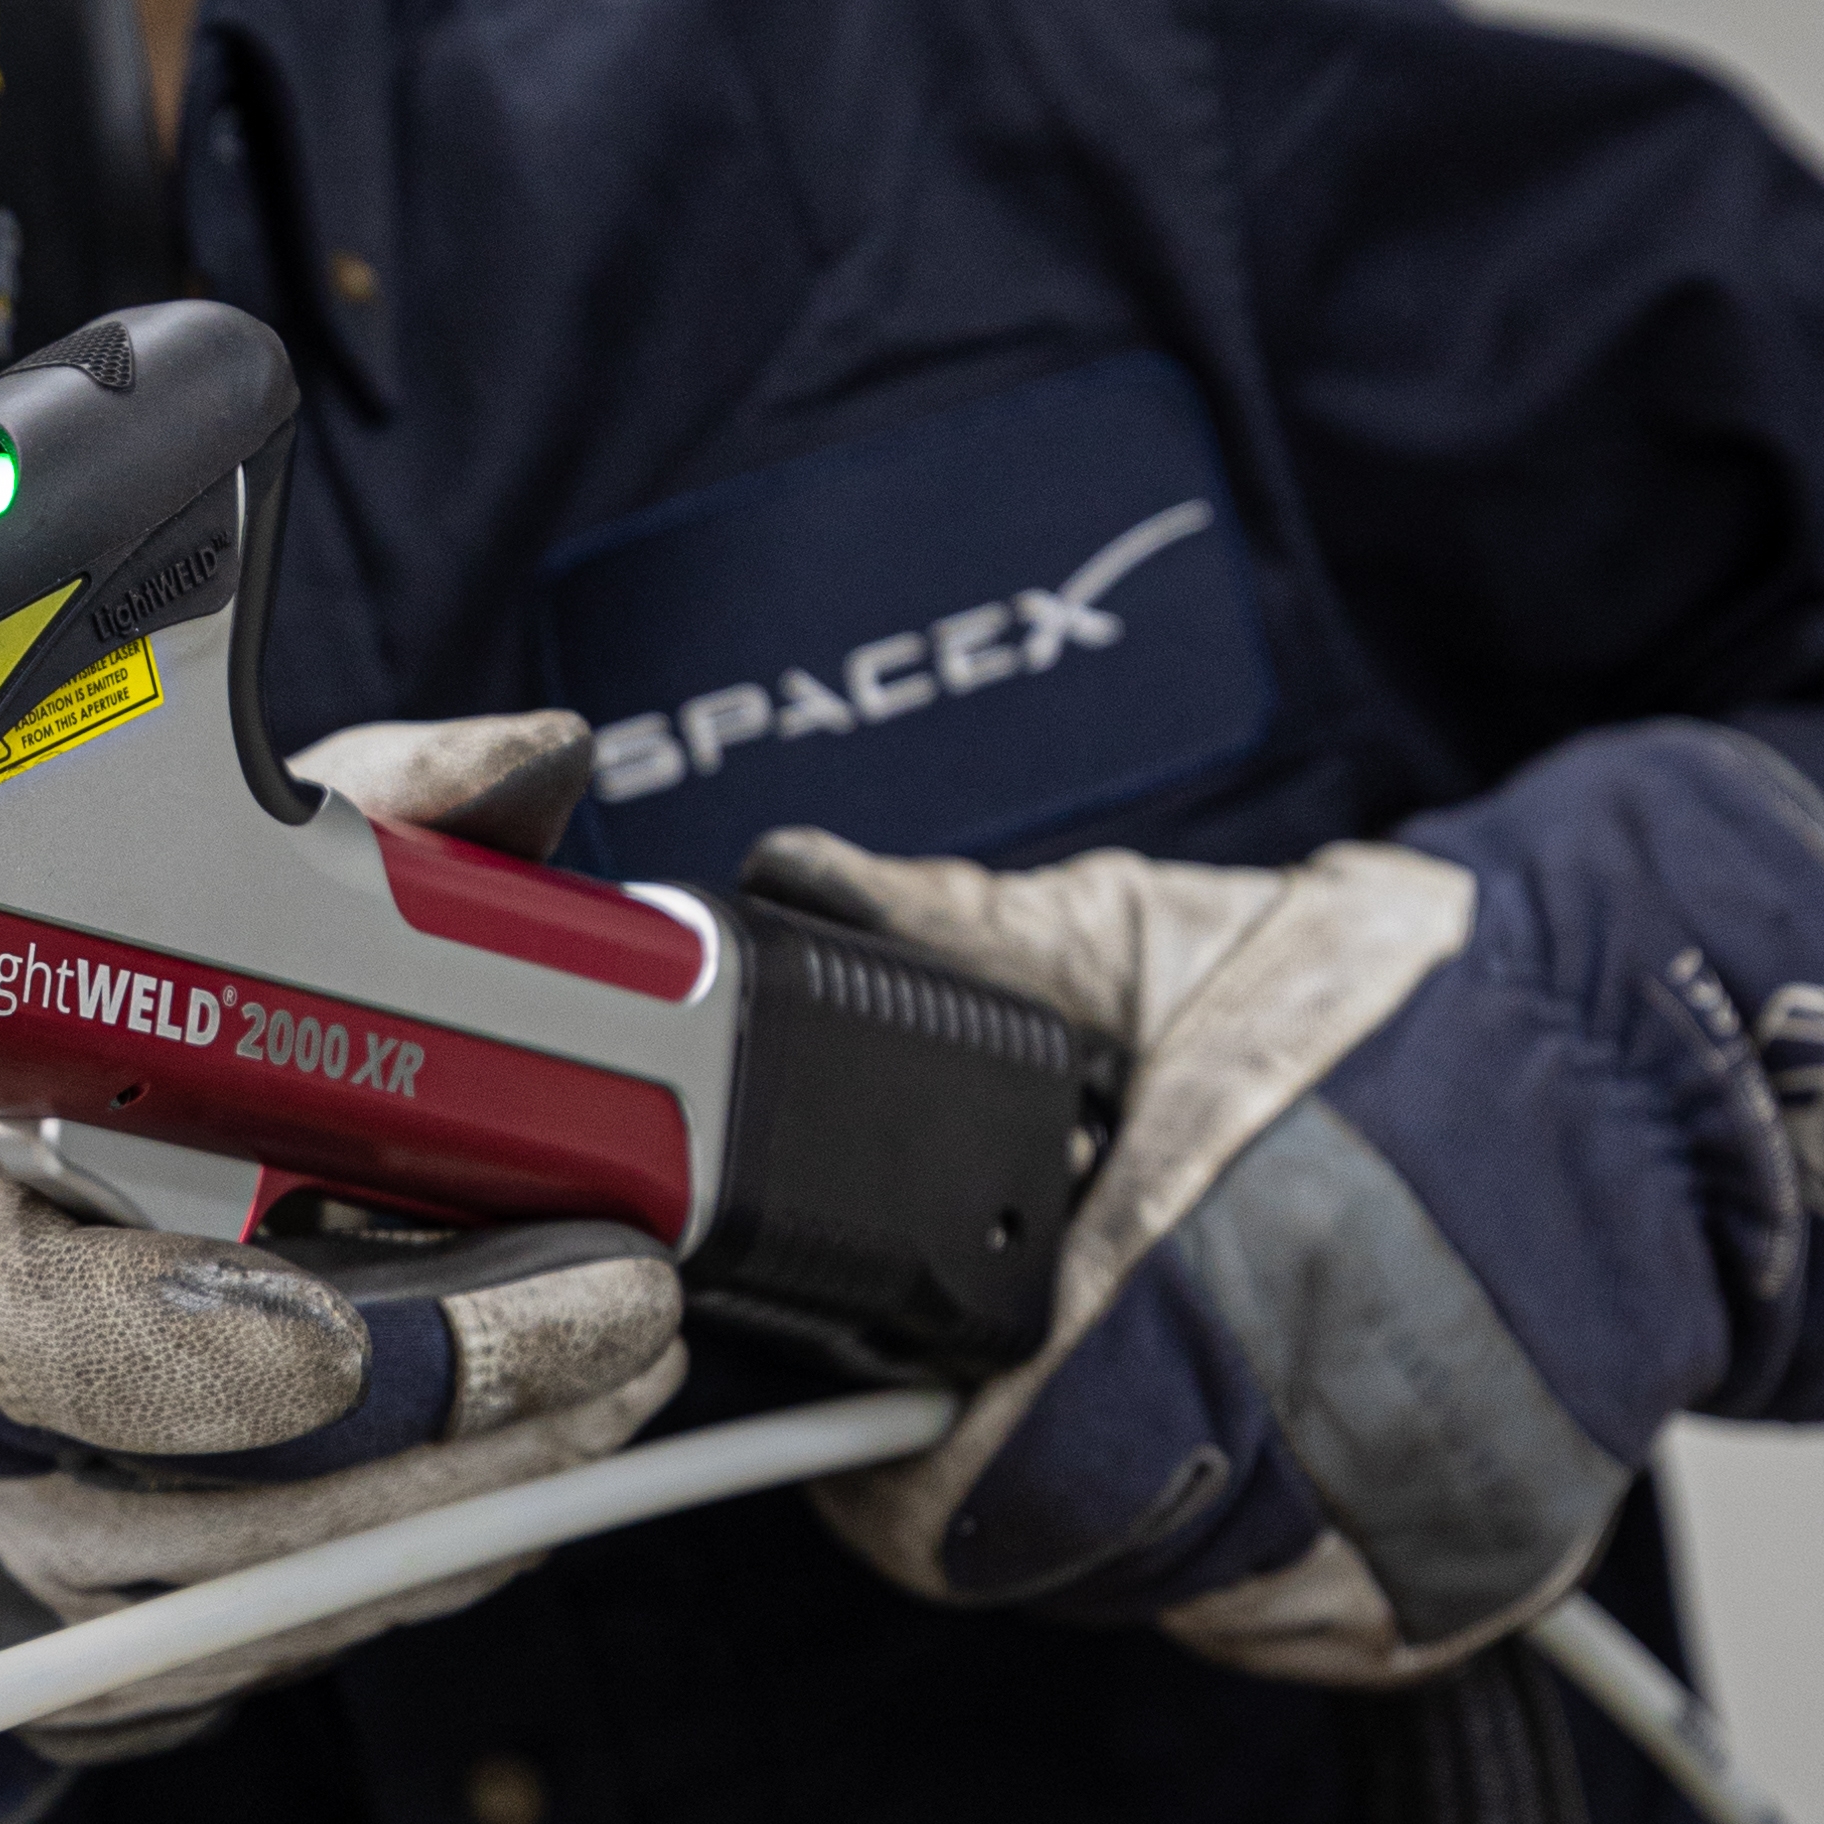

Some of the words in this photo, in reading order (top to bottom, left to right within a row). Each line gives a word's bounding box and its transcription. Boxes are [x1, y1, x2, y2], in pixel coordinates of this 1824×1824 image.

[109, 641, 141, 666] LASER
[590, 497, 1215, 805] SPACEX
[75, 687, 86, 703] IS
[87, 667, 128, 697] EMITTED
[21, 723, 55, 749] FROM
[55, 711, 78, 733] THIS
[80, 686, 130, 722] APERTURE
[236, 1002, 349, 1080] 2000
[350, 1032, 424, 1098] XR
